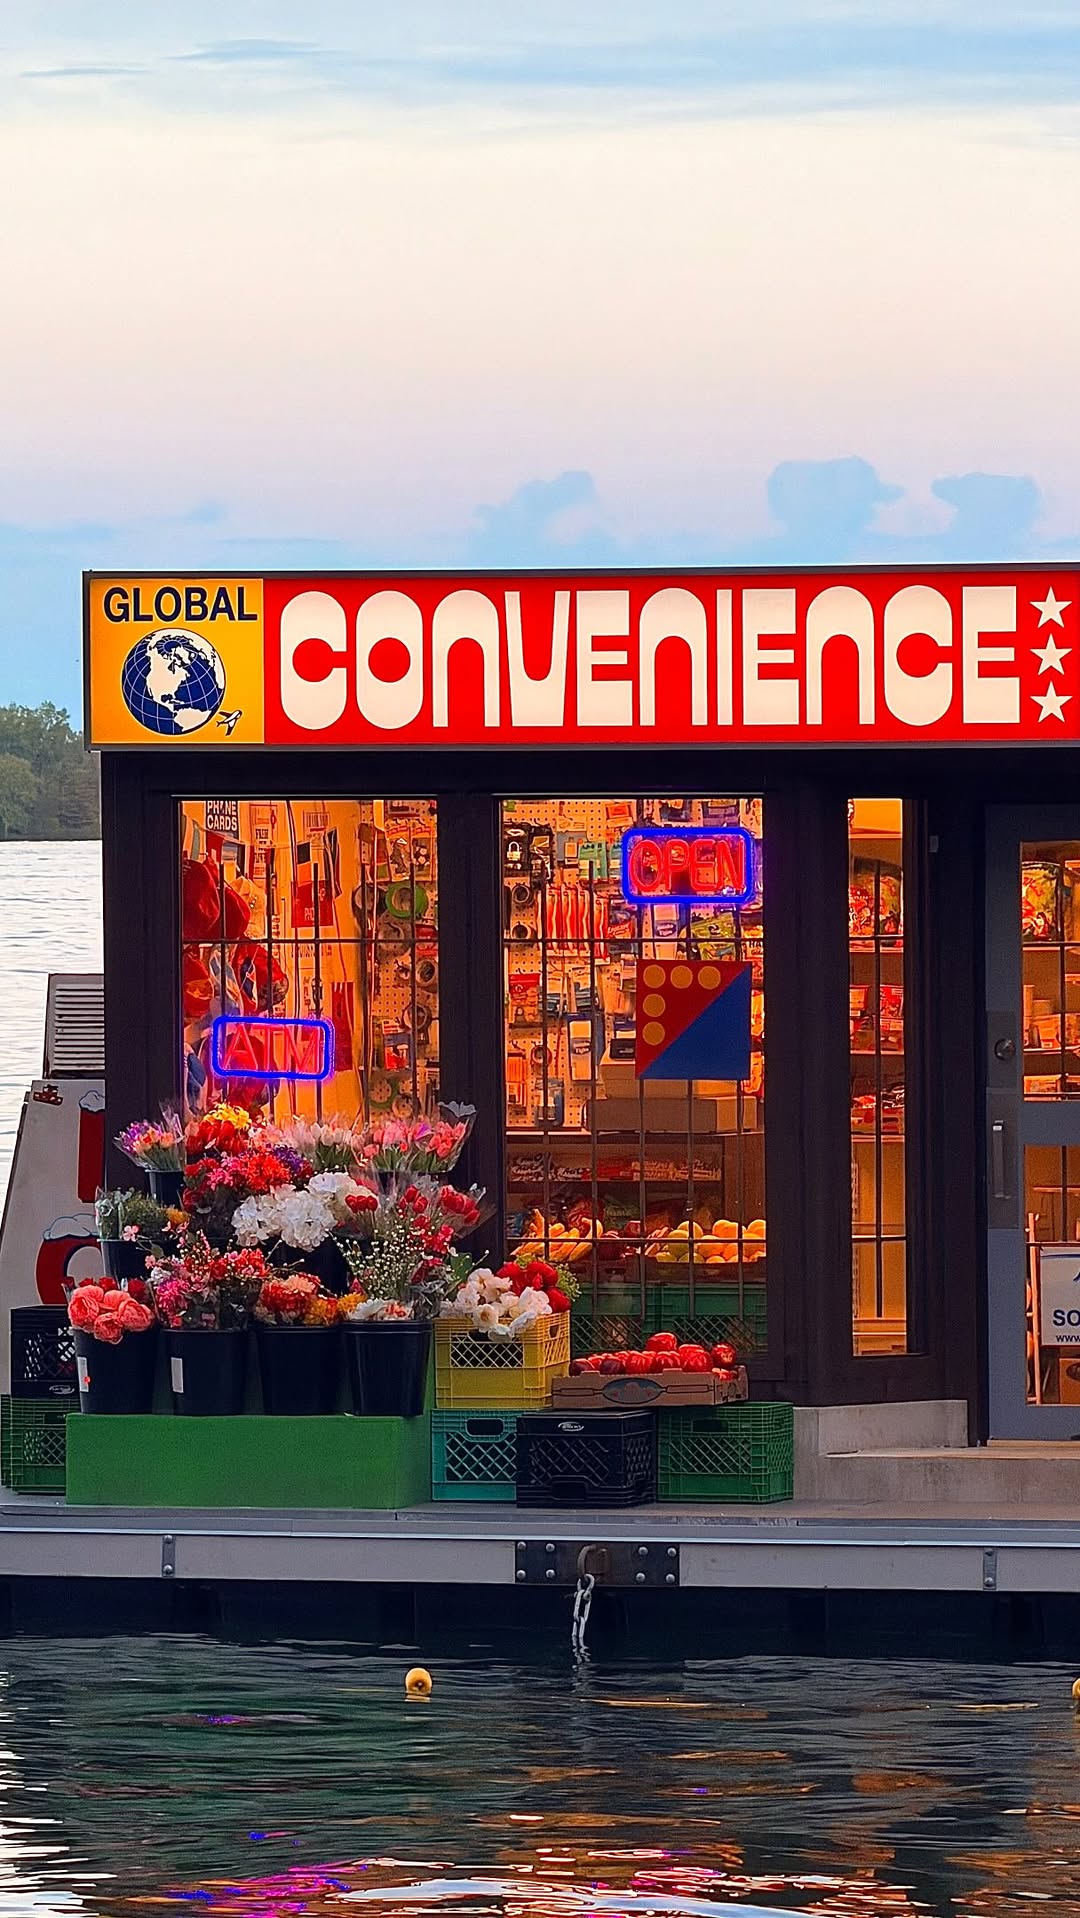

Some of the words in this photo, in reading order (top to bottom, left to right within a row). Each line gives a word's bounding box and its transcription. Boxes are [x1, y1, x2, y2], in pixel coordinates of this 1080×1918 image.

[103, 586, 258, 623] GLOBAL
[280, 585, 1020, 730] CONVENIENCE
[207, 814, 237, 831] CARDS
[628, 838, 746, 894] OPEN
[221, 1022, 322, 1073] ATM
